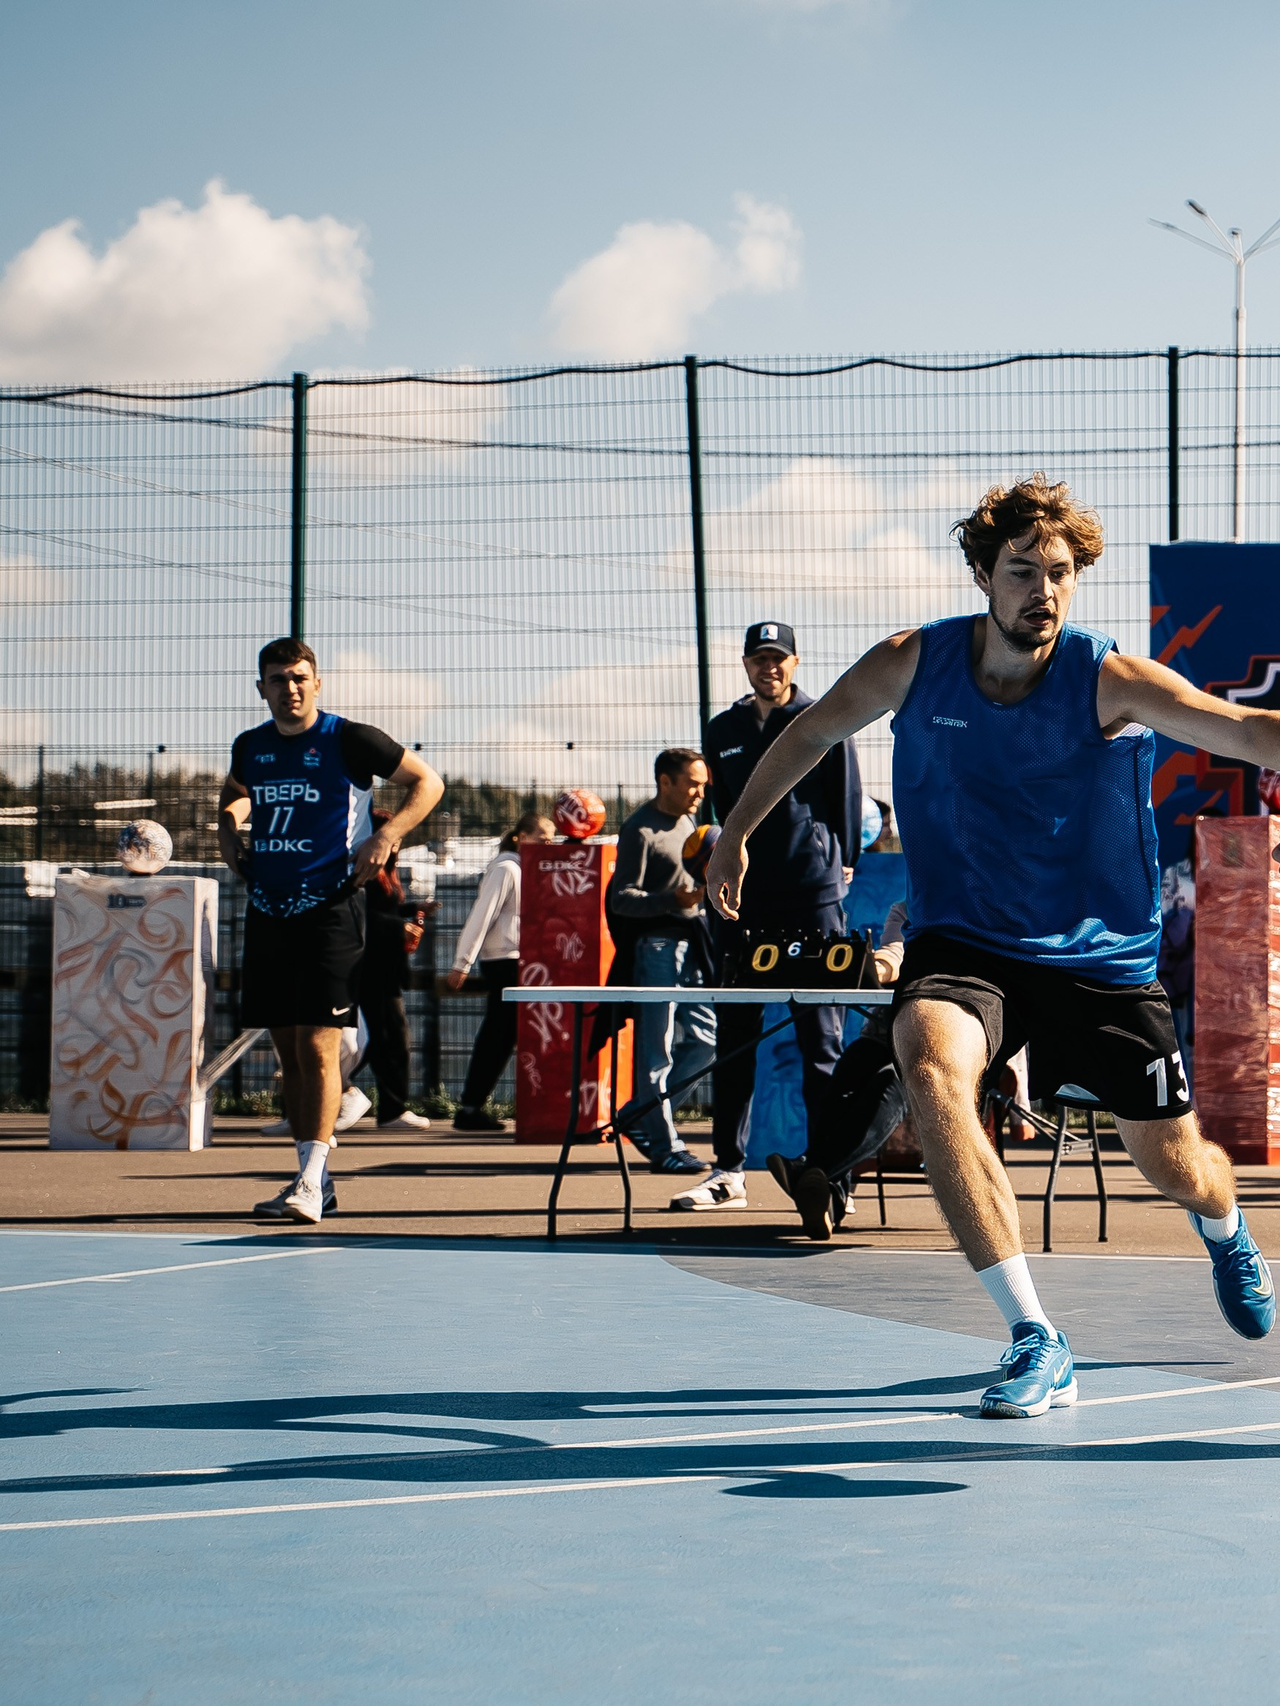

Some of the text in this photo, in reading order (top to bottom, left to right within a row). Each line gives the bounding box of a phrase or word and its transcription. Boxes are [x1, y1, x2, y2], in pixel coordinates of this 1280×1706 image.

[252, 784, 321, 806] ТВЕРЬ
[268, 806, 295, 834] 17
[752, 942, 853, 972] 0 6 0
[1146, 1050, 1190, 1107] 13
